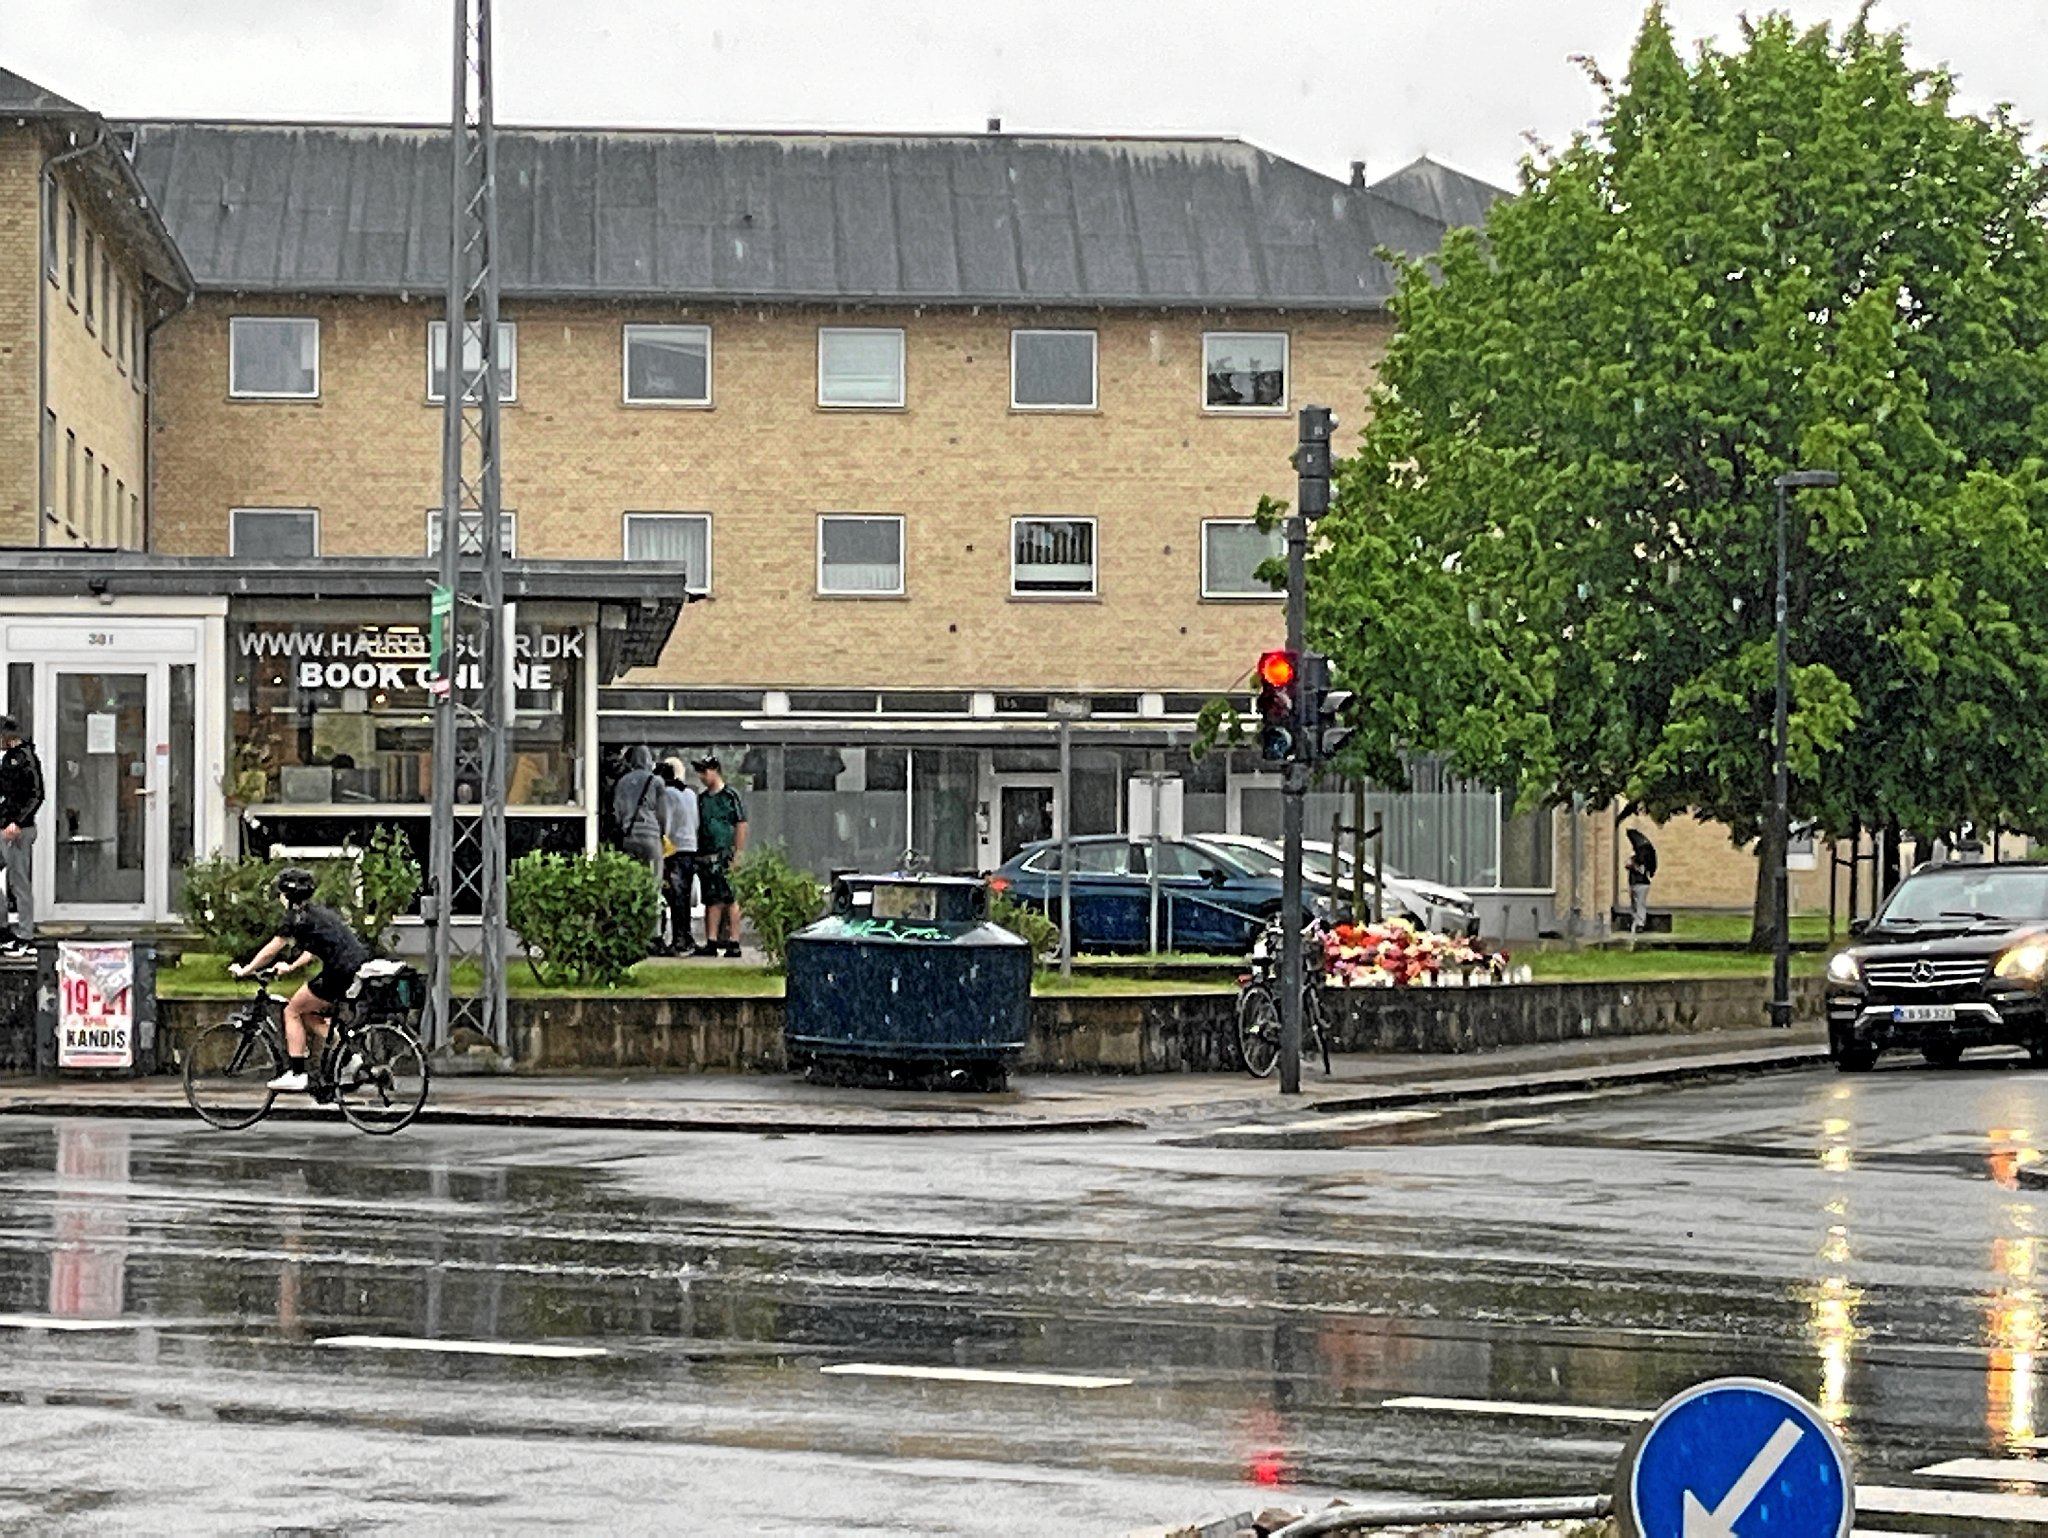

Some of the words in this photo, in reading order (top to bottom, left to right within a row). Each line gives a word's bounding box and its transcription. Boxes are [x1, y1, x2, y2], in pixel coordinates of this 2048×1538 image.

[300, 662, 404, 690] BOOK
[415, 663, 552, 690] ONLNE
[66, 1029, 125, 1048] KANDIS
